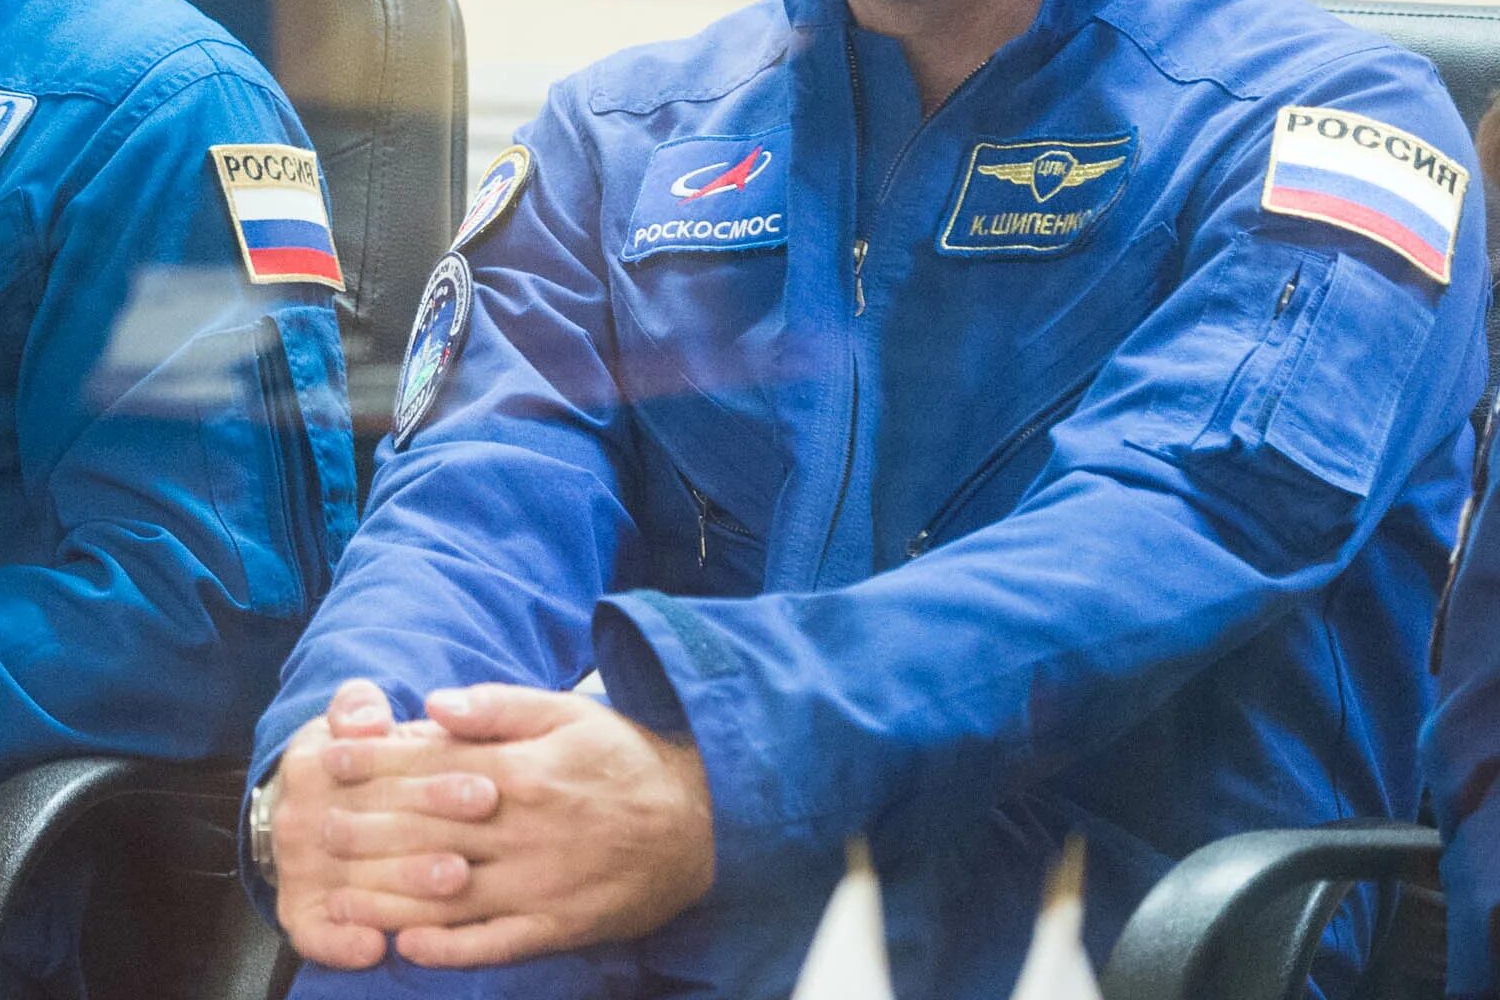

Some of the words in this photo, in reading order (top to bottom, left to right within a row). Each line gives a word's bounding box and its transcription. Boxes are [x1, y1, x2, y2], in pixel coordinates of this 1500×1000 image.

[223, 154, 316, 188] РОССИЯ
[1286, 112, 1458, 196] РОССИЯ
[633, 213, 782, 249] РОСКОСМОС
